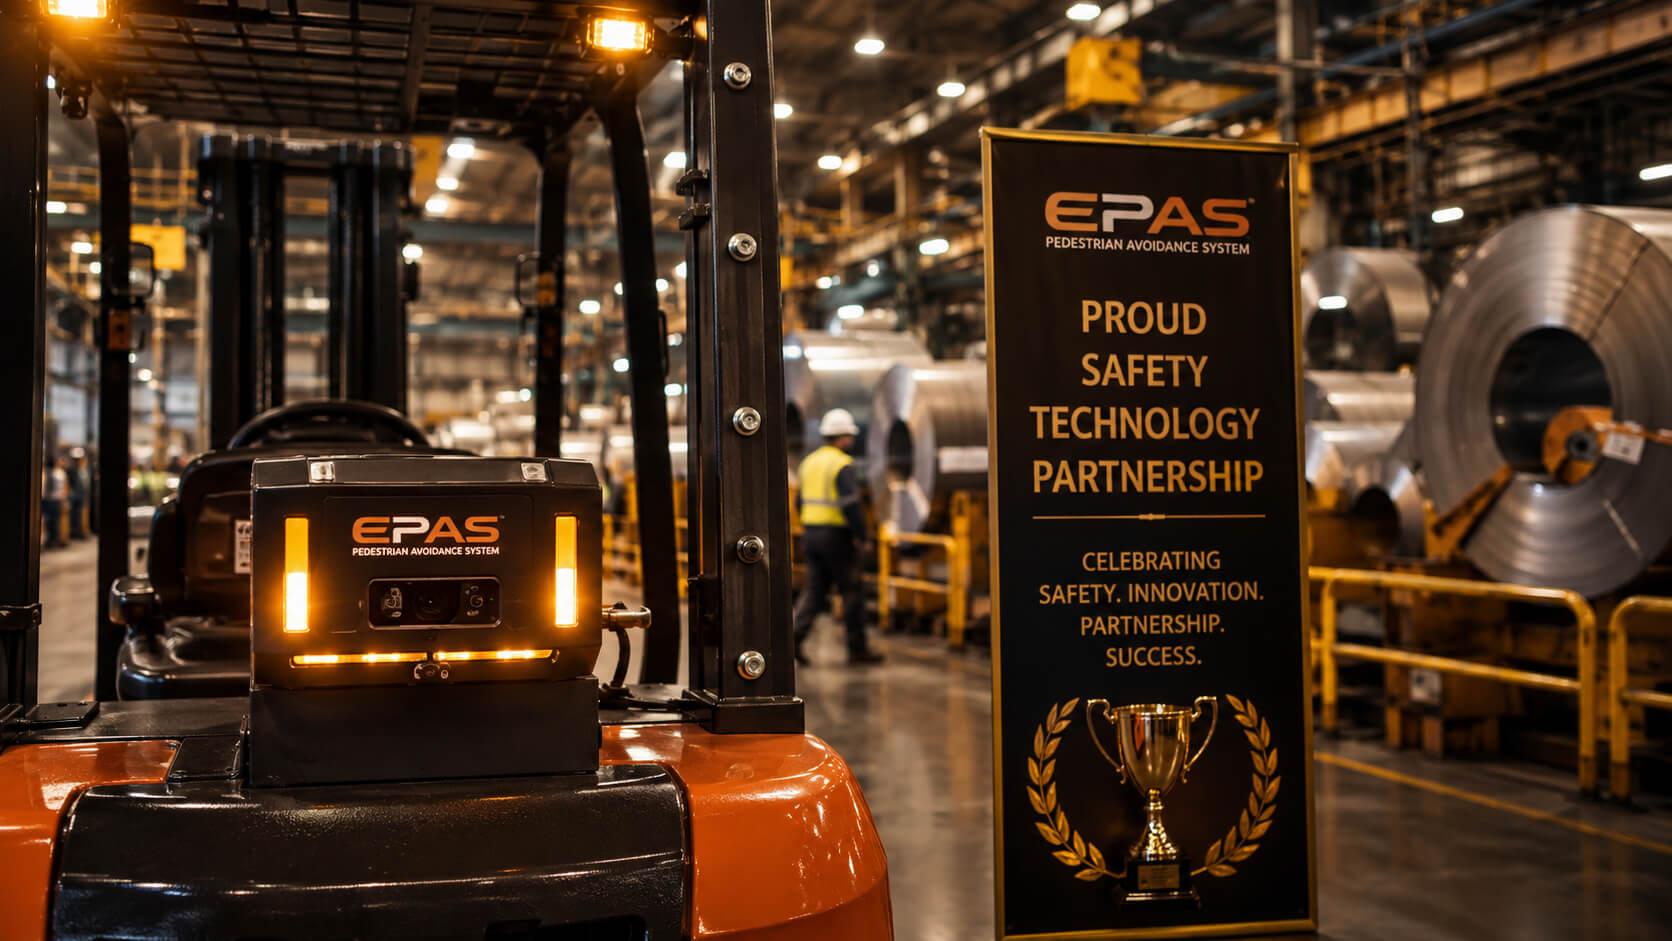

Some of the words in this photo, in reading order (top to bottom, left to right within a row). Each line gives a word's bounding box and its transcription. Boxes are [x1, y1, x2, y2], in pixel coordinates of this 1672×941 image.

[1045, 192, 1250, 237] EPAS
[1046, 236, 1123, 251] PEDESTRIAN
[1126, 239, 1199, 254] AVOIDANCE
[1202, 242, 1250, 255] SYSTEM
[1082, 300, 1207, 335] PROUD
[1081, 353, 1208, 388] SAFETY
[1029, 406, 1260, 440] TECHNOLOGY
[1033, 460, 1264, 493] PARTNERSHIP
[352, 516, 500, 544] EPAS
[352, 547, 409, 556] PEDESTRIAN
[410, 547, 463, 556] AVOIDANCE
[465, 546, 500, 555] SYSTEM
[1082, 550, 1221, 572] CELEBRATING
[1039, 583, 1121, 604] SAFETY.
[1128, 581, 1264, 603] INNOVATION.
[1081, 614, 1225, 636] PARTNERSHIP.
[1106, 646, 1202, 667] SUCCESS.
